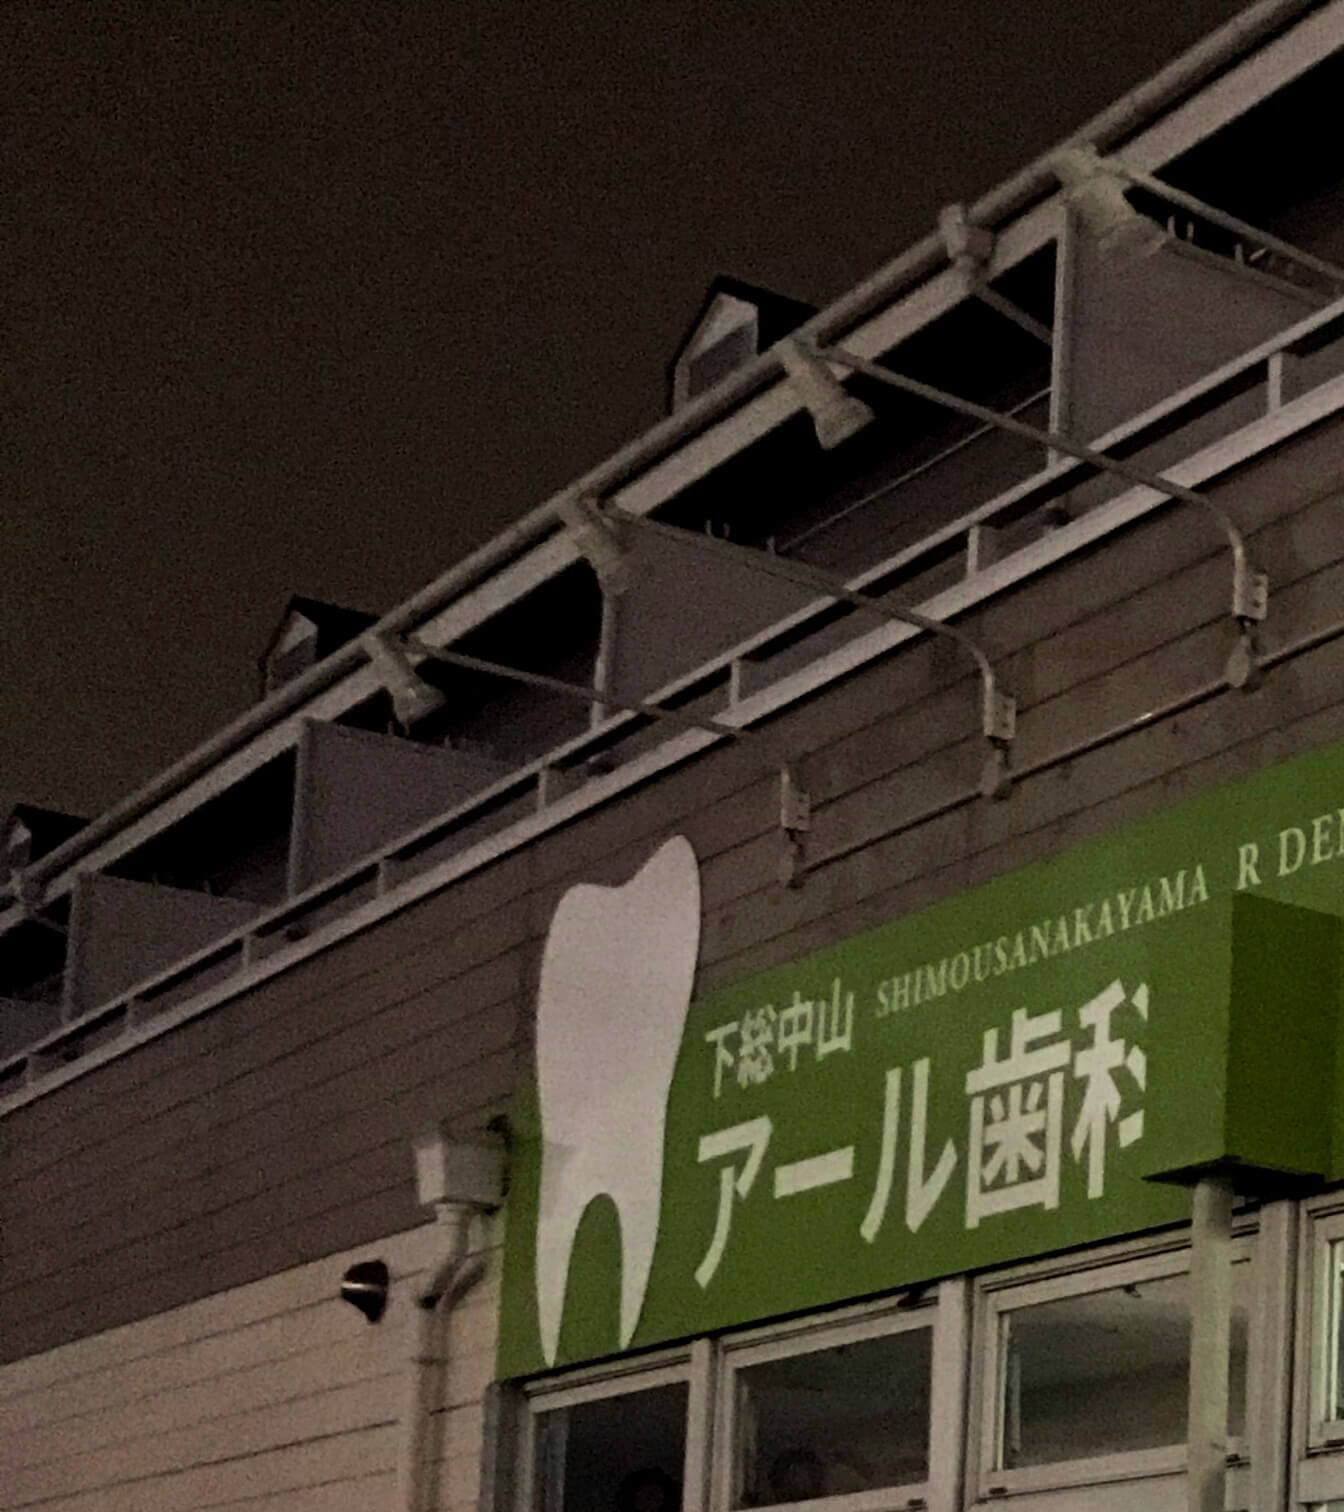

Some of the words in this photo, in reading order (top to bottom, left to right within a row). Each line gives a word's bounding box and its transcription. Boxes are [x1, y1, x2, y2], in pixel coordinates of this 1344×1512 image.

[705, 976, 856, 1099] 下総中山
[874, 863, 1209, 1019] SHIMOUSANAKAYAMA
[1234, 842, 1262, 891] R
